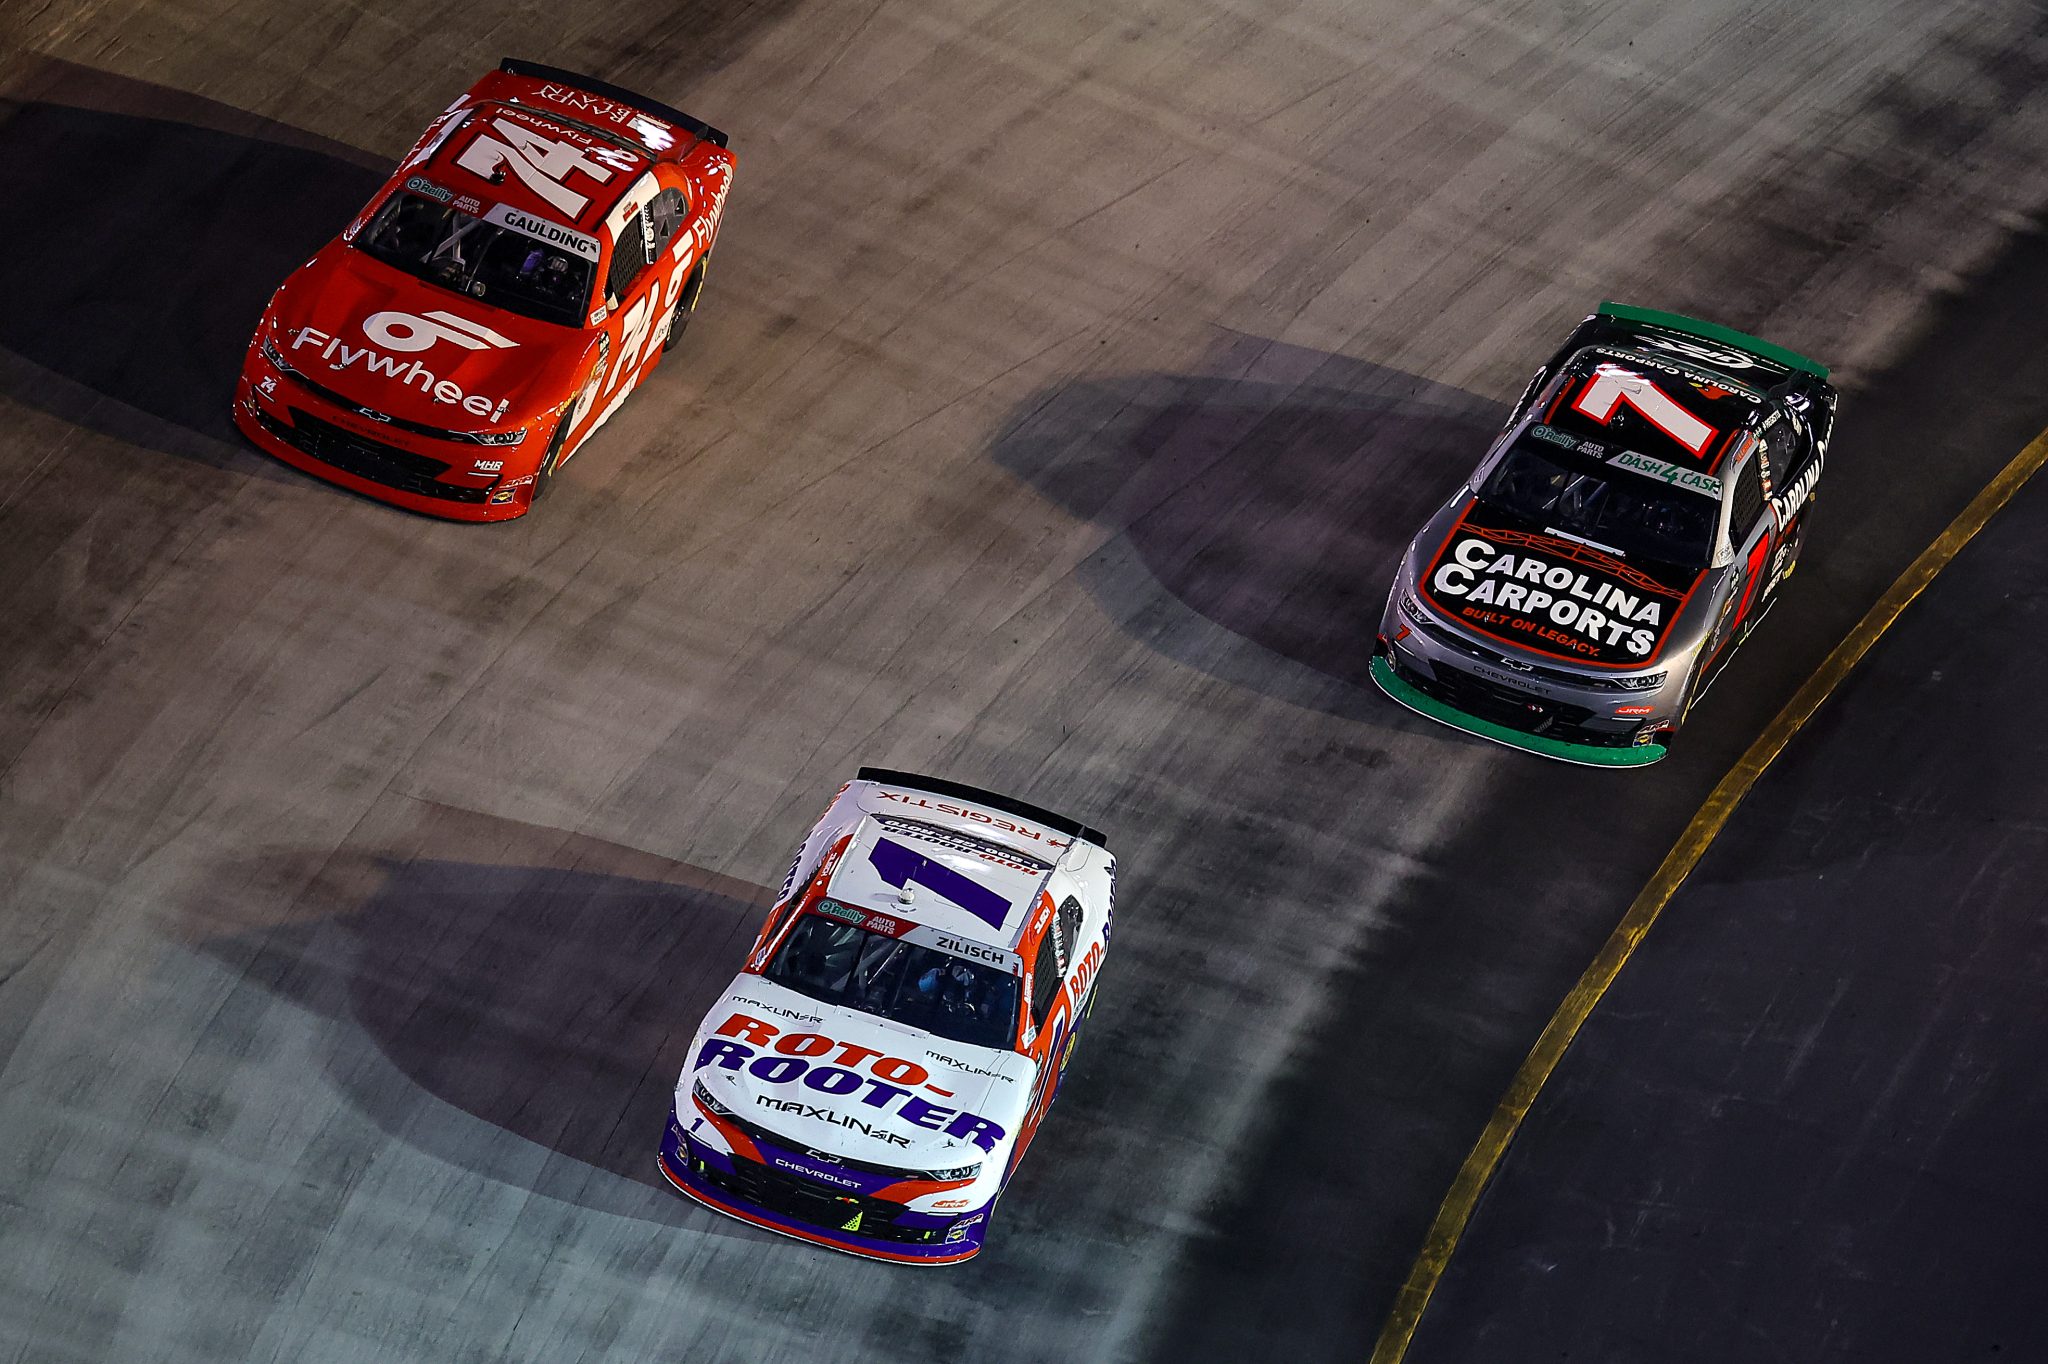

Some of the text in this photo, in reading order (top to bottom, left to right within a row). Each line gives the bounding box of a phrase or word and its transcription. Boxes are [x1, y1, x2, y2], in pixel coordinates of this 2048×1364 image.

[531, 88, 625, 123] RANDY
[457, 117, 613, 219] 74
[407, 177, 454, 202] O'Reilly
[458, 195, 480, 206] AUTO
[452, 200, 480, 214] PARTS
[504, 211, 589, 253] GAULDING
[260, 375, 277, 394] 74
[291, 326, 510, 424] Flywheel
[1596, 347, 1762, 404] CAROLINA CARPORTS
[1572, 364, 1719, 460] 7
[1532, 425, 1577, 449] O'Reilly
[1576, 446, 1603, 459] PARTS
[1583, 441, 1605, 452] AUTO
[474, 460, 504, 471] MHR
[1618, 453, 1663, 474] DASH
[1660, 464, 1680, 485] 4
[1771, 458, 1820, 532] CAROLINA
[1454, 539, 1661, 626] CAROLINA
[1434, 563, 1655, 656] CARPORTS
[1461, 606, 1511, 624] BUILT
[1511, 617, 1538, 633] ON
[1395, 623, 1412, 641] 7
[1473, 665, 1552, 696] CHEVROLET
[876, 790, 1041, 841] REGISTIX
[868, 836, 1012, 932] 1
[817, 899, 867, 924] O'Reilly
[866, 920, 895, 934] PARTS
[872, 916, 896, 928] AUTO
[936, 936, 1005, 964] ZILISCH
[714, 1013, 955, 1098] ROTO-
[693, 1038, 1006, 1155] ROOTER
[690, 1117, 705, 1133] 1
[775, 1158, 861, 1189] CHEVROLET
